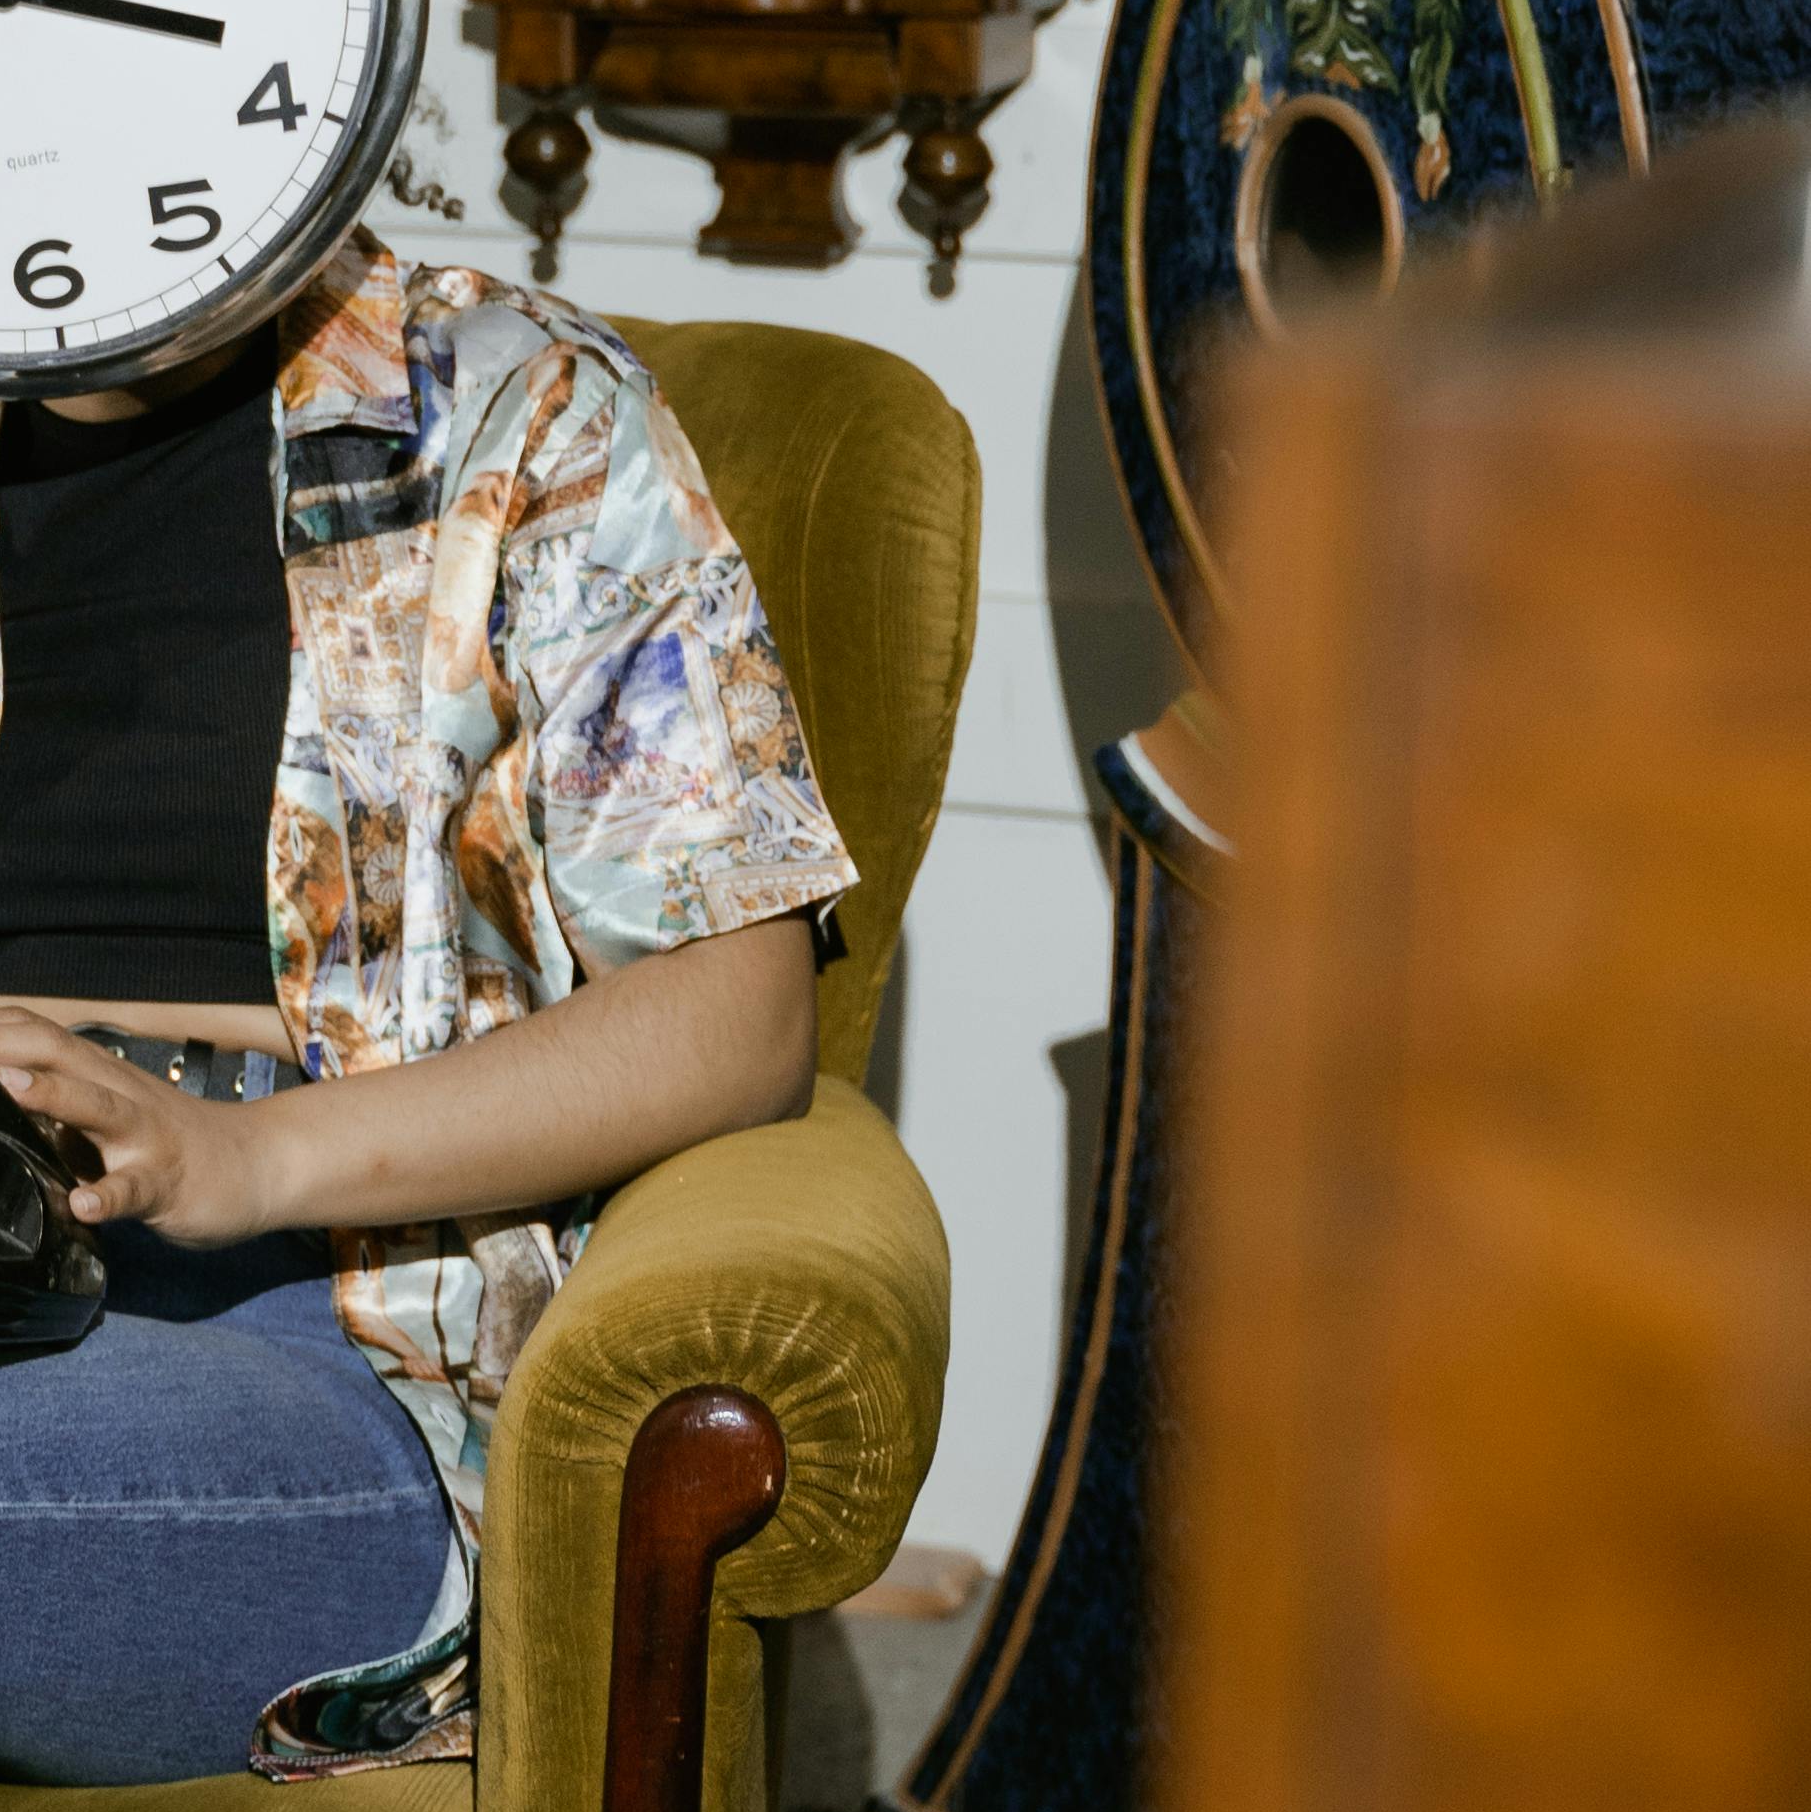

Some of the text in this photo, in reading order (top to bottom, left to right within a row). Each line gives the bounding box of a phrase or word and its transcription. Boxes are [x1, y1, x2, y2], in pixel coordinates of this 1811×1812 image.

[236, 61, 308, 133] 4
[6, 149, 61, 172] quartz
[147, 178, 222, 253] 5
[12, 238, 86, 310] 6
